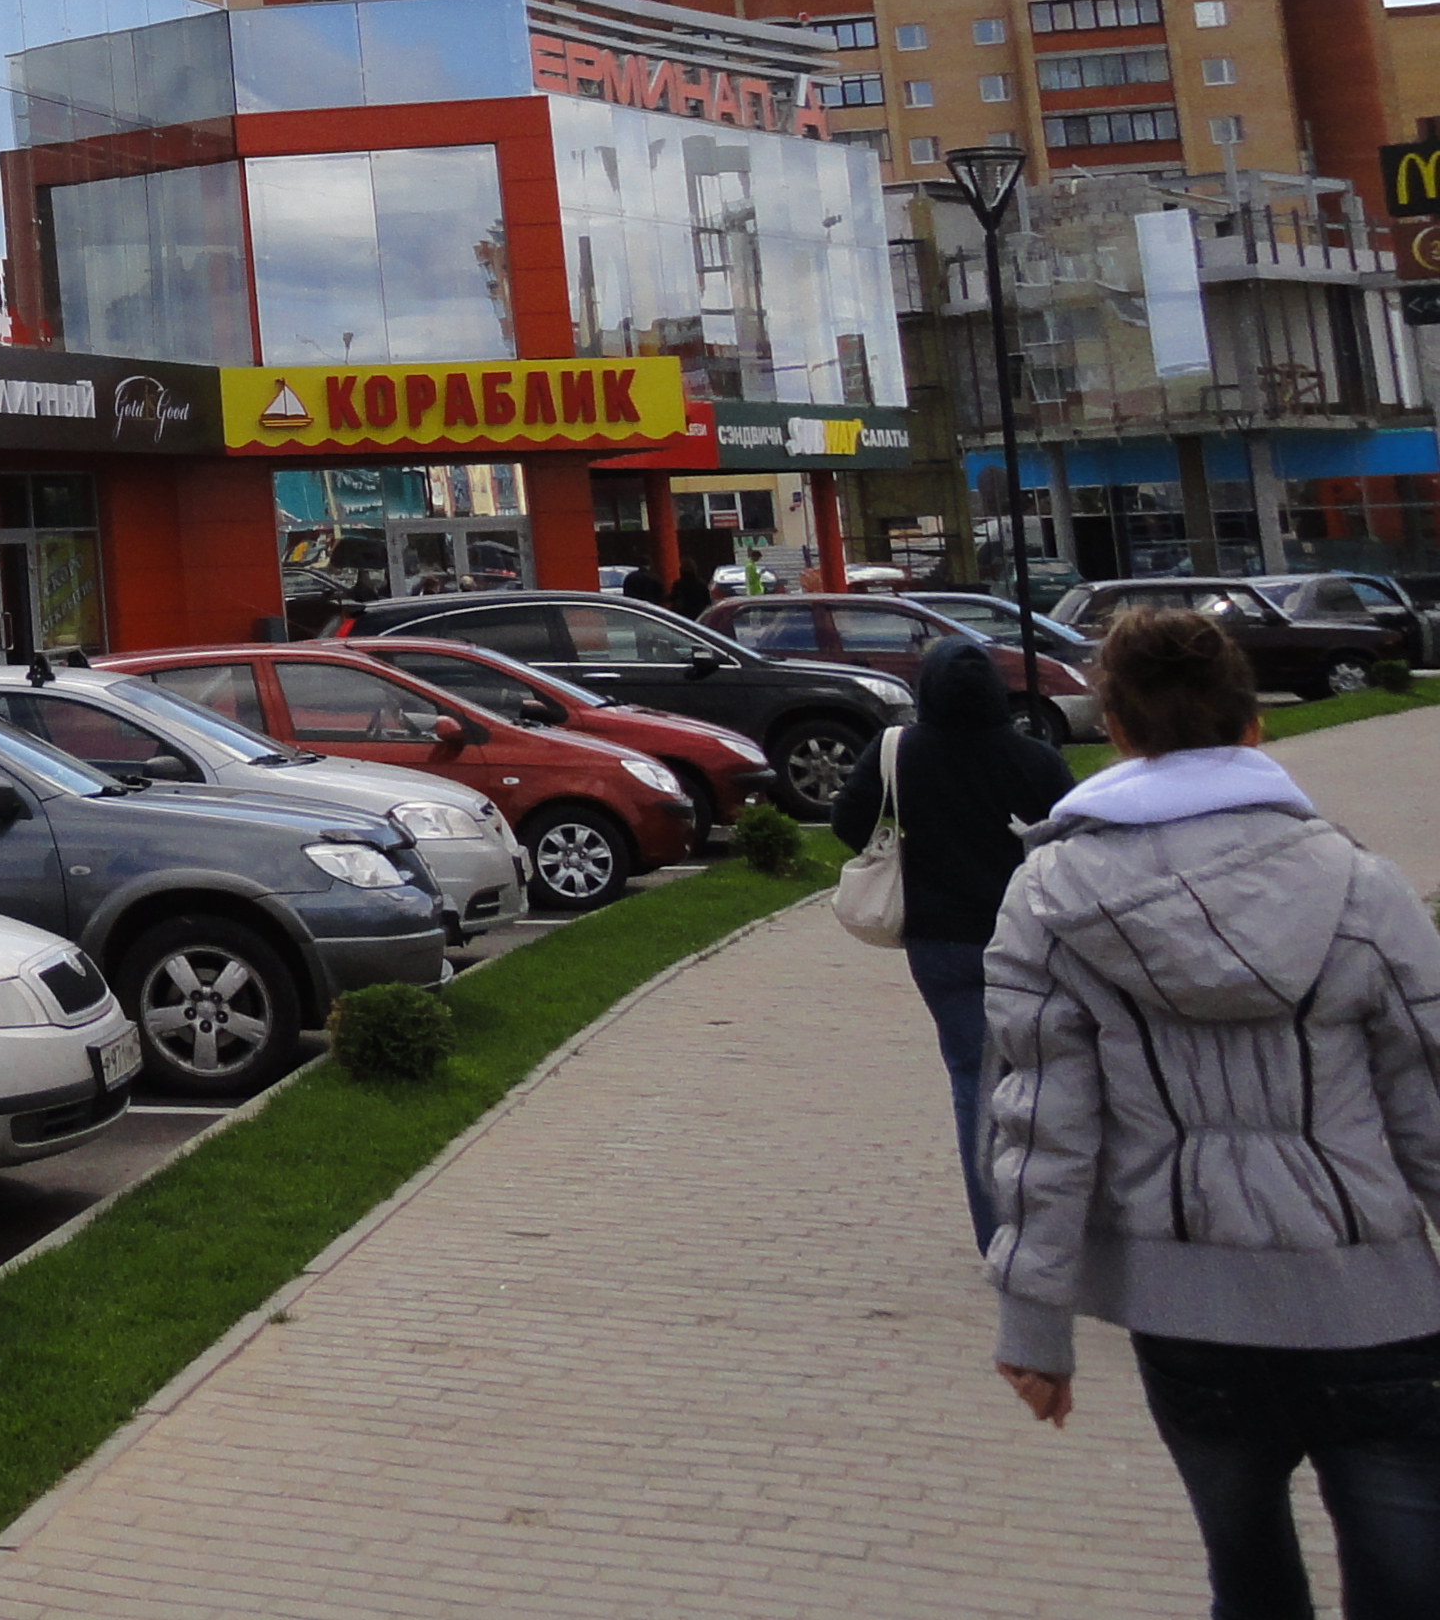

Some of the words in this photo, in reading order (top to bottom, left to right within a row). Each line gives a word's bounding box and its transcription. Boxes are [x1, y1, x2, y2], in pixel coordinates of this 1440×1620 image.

[154, 388, 190, 443] Good
[325, 368, 641, 429] КОРАБЛИК
[717, 425, 783, 449] СЭНДВИЧИ
[861, 428, 910, 448] САЛАТЫ
